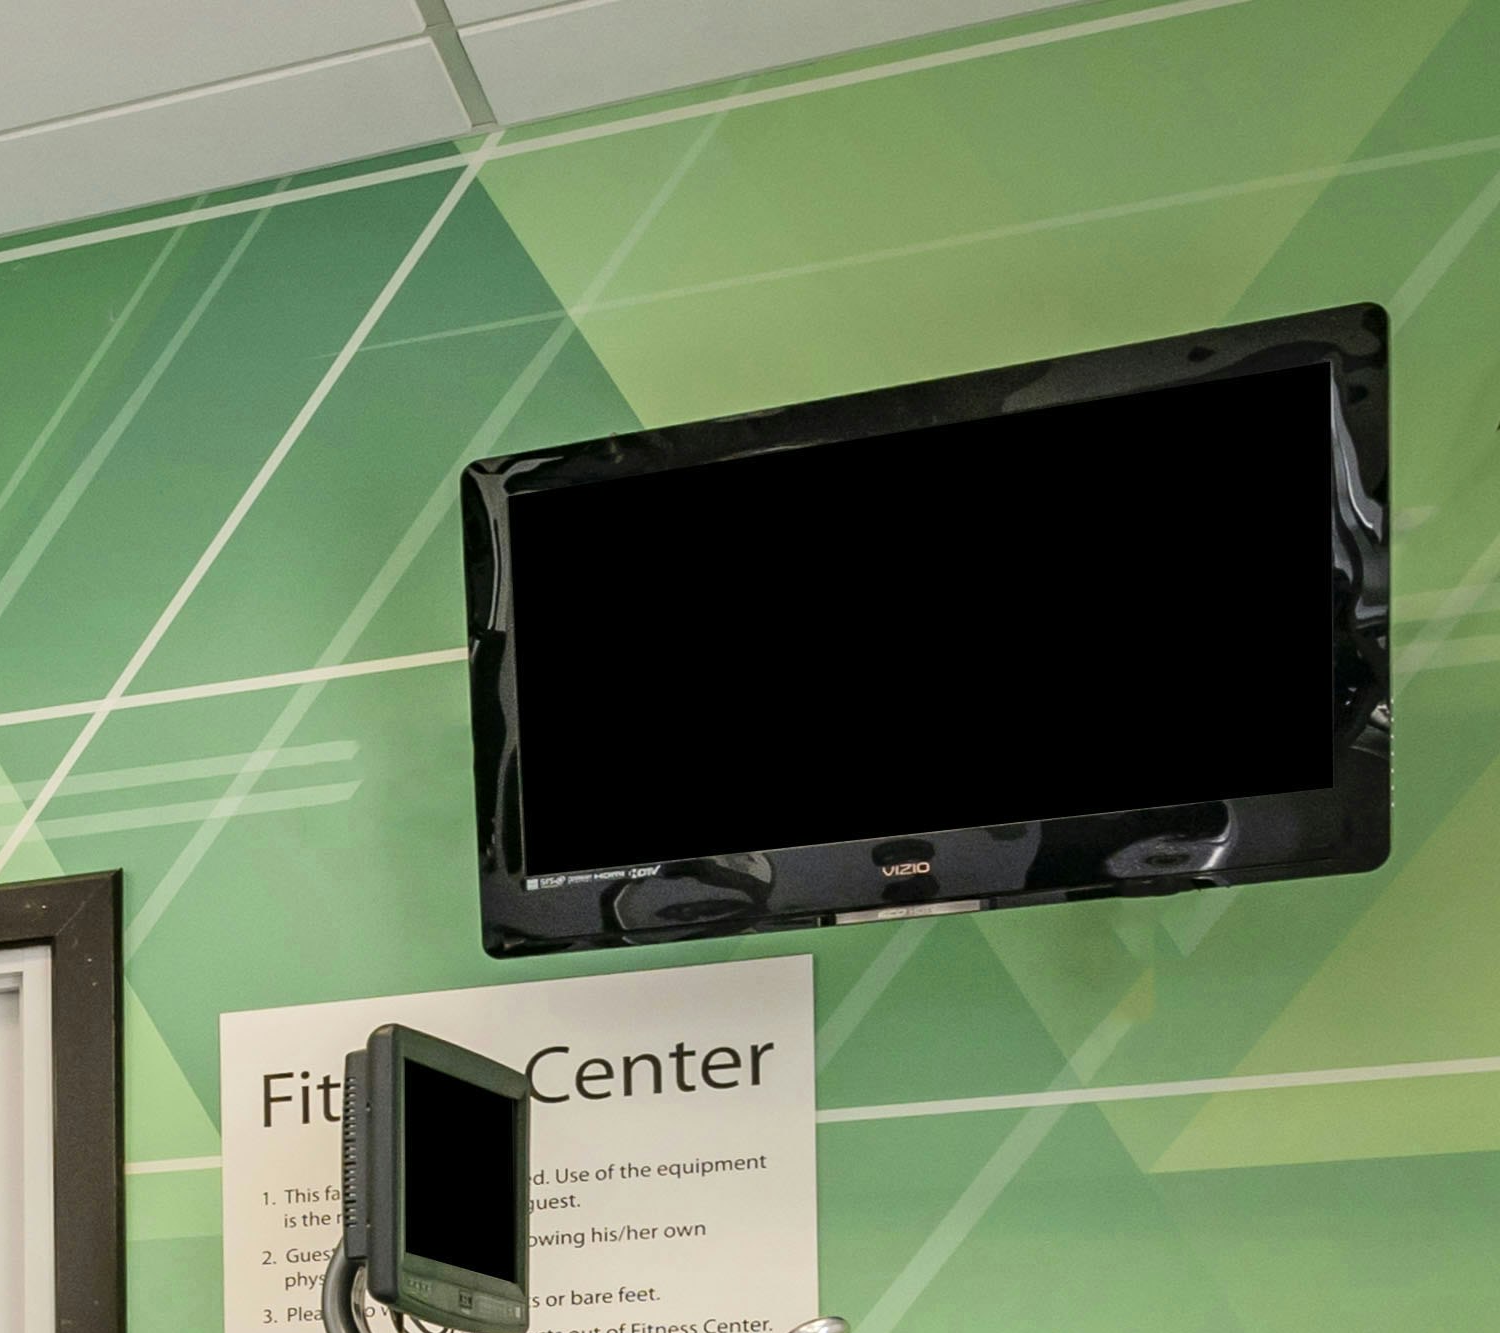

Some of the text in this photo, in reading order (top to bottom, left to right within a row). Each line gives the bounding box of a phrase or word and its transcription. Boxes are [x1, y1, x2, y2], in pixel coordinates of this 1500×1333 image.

[882, 861, 931, 877] VIZIO
[525, 1041, 775, 1103] Center
[262, 1192, 277, 1206] 1.
[285, 1188, 320, 1204] This
[556, 1168, 590, 1184] Use
[595, 1164, 616, 1181] of
[620, 1163, 651, 1179] the
[657, 1155, 767, 1179] equipment
[284, 1214, 297, 1228] is
[302, 1211, 331, 1227] the
[262, 1250, 277, 1265] 2.
[591, 1225, 658, 1243] his/her
[664, 1223, 706, 1239] own
[263, 1309, 278, 1324] 3.
[545, 1294, 565, 1307] or
[571, 1290, 613, 1306] bare
[619, 1286, 660, 1302] feet.
